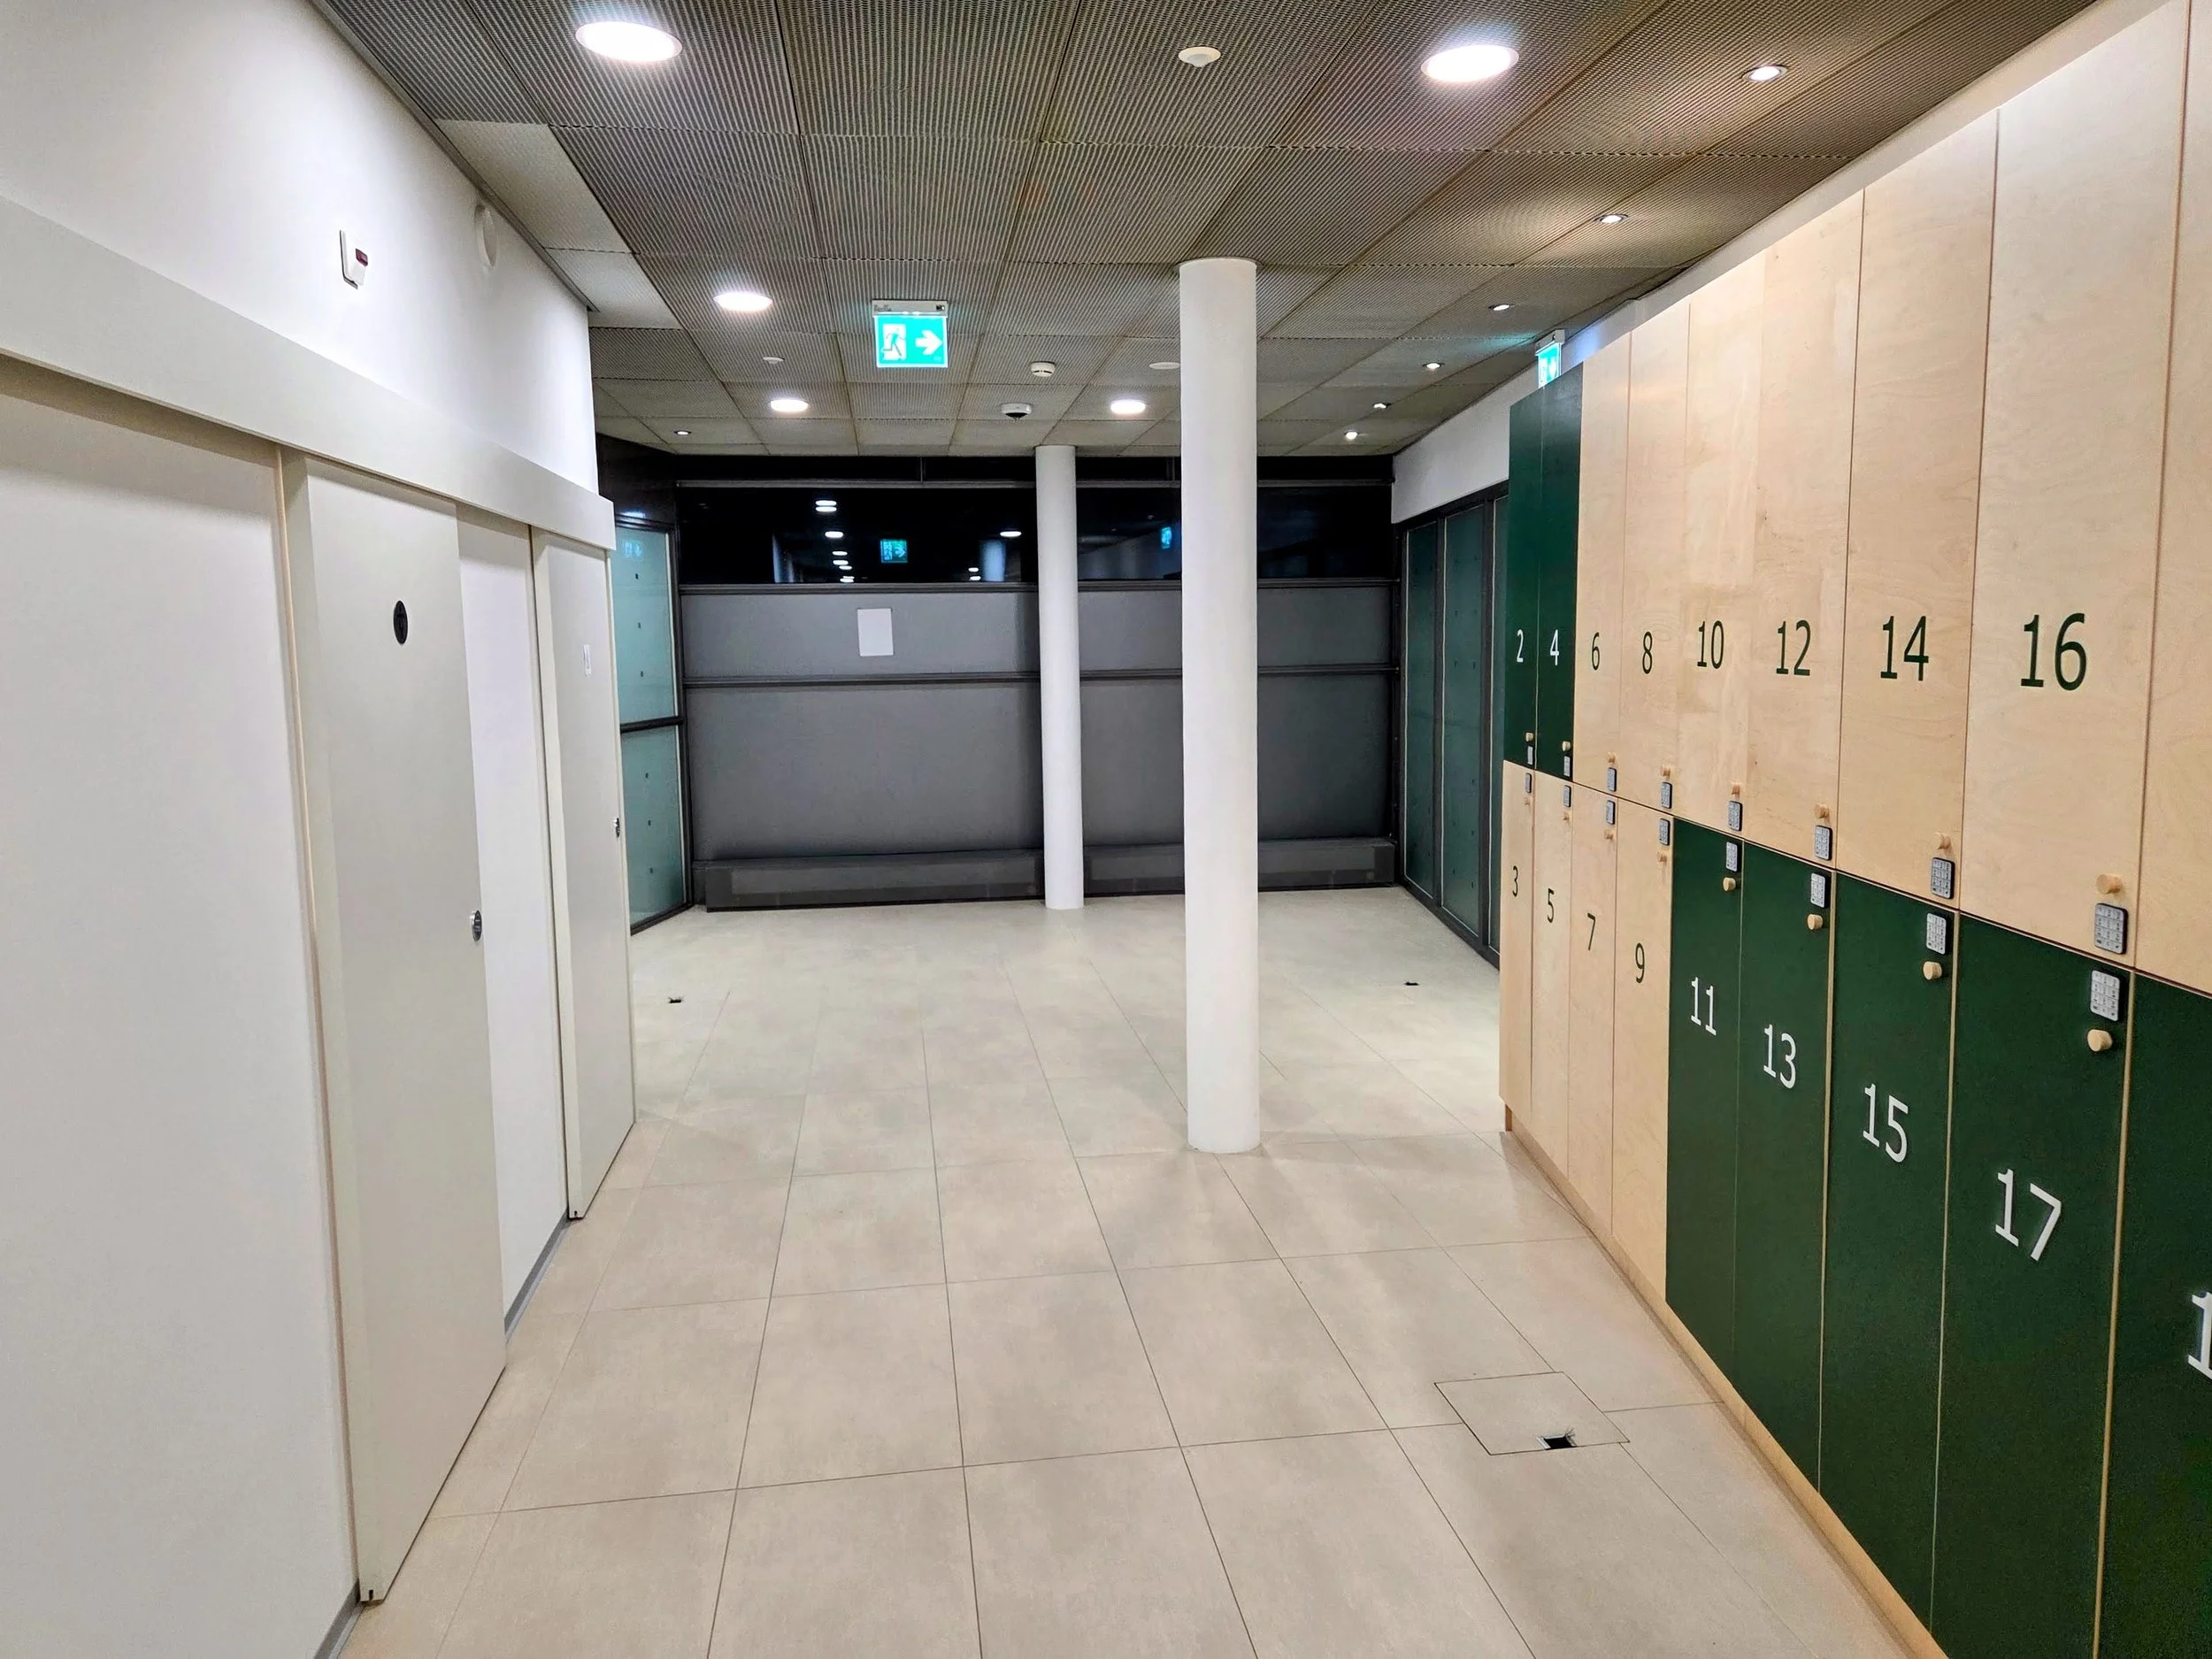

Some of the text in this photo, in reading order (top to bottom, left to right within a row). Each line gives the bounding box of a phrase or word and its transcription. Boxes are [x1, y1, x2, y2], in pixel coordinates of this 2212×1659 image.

[1516, 629, 1524, 663] 2
[1549, 629, 1560, 666] 4
[1591, 632, 1601, 671] 6
[1641, 631, 1653, 675] 8
[1696, 620, 1724, 670] 10
[1776, 619, 1811, 677] 12
[1880, 615, 1930, 681] 14
[2020, 613, 2087, 690] 16
[1511, 864, 1519, 898] 3
[1547, 887, 1555, 924] 5
[1586, 912, 1596, 951] 7
[1635, 942, 1646, 984] 9
[1690, 976, 1717, 1036] 11
[1763, 1024, 1796, 1089] 13
[1863, 1083, 1909, 1163] 15
[1995, 1168, 2062, 1261] 17
